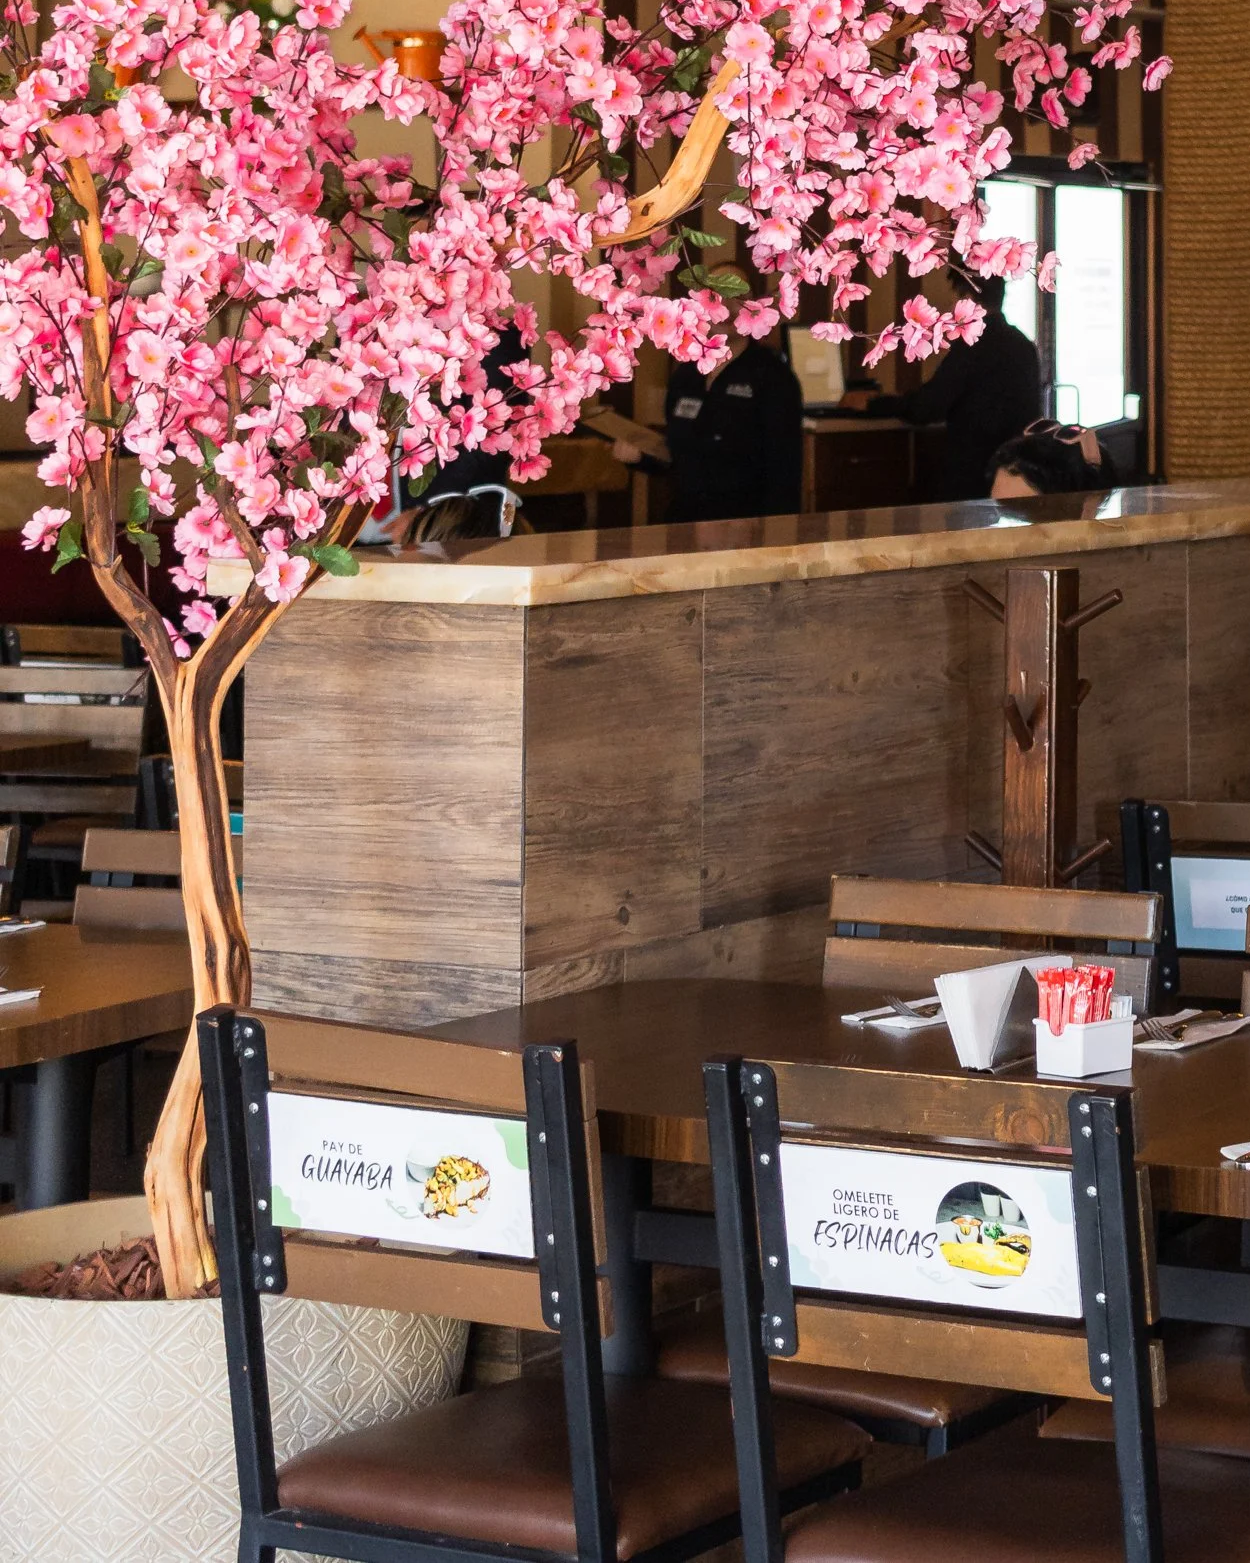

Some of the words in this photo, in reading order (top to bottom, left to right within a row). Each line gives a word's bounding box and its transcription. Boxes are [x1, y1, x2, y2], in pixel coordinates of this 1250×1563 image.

[322, 1140, 345, 1152] PAY
[348, 1143, 363, 1155] DE
[301, 1154, 393, 1191] GUAYABA
[833, 1189, 894, 1206] OMELETTE
[833, 1203, 879, 1218] LIGERO
[884, 1208, 900, 1221] DE
[814, 1220, 938, 1259] ESPINACAS
